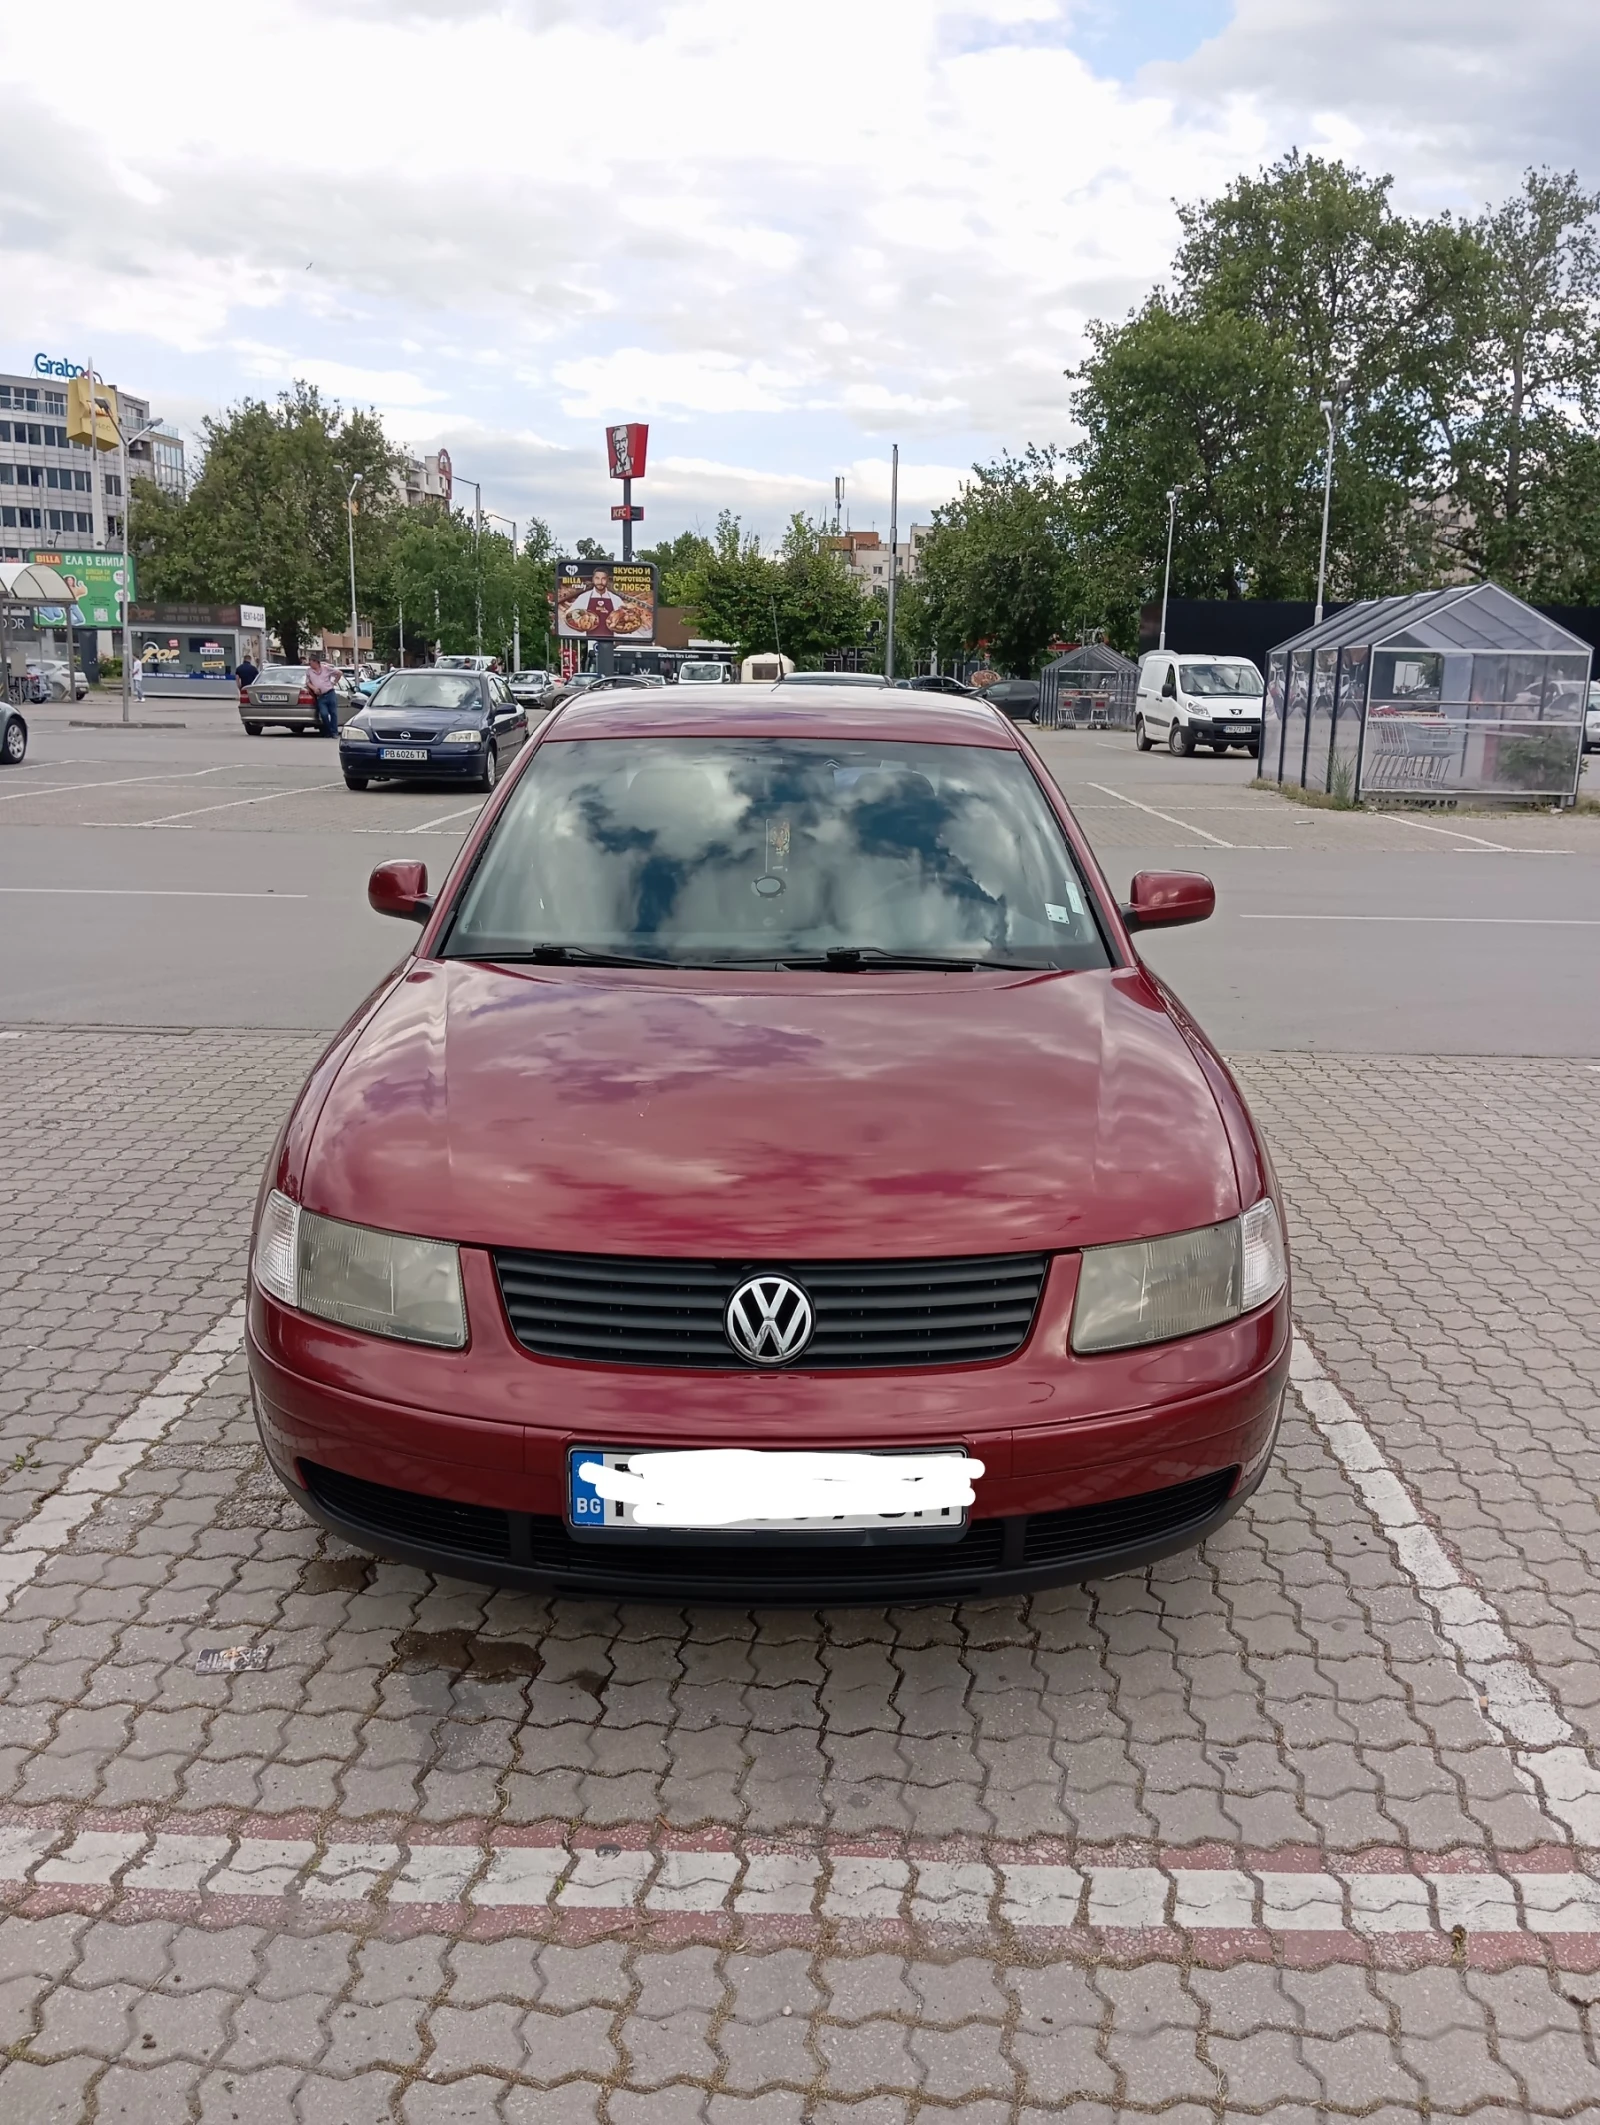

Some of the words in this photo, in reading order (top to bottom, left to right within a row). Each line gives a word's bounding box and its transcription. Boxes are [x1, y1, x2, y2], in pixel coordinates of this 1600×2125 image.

[613, 508, 627, 517] KFC
[35, 554, 61, 563] BILLA
[65, 555, 84, 565] ЕЛА
[86, 556, 93, 566] В
[613, 567, 643, 575] ВКУСНО
[644, 567, 651, 575] И
[243, 611, 265, 622] RENT-A-CAR
[141, 648, 180, 664] TOP
[385, 750, 395, 758] PB
[396, 750, 415, 758] 6026
[416, 751, 426, 759] TX
[576, 1497, 601, 1514] BG
